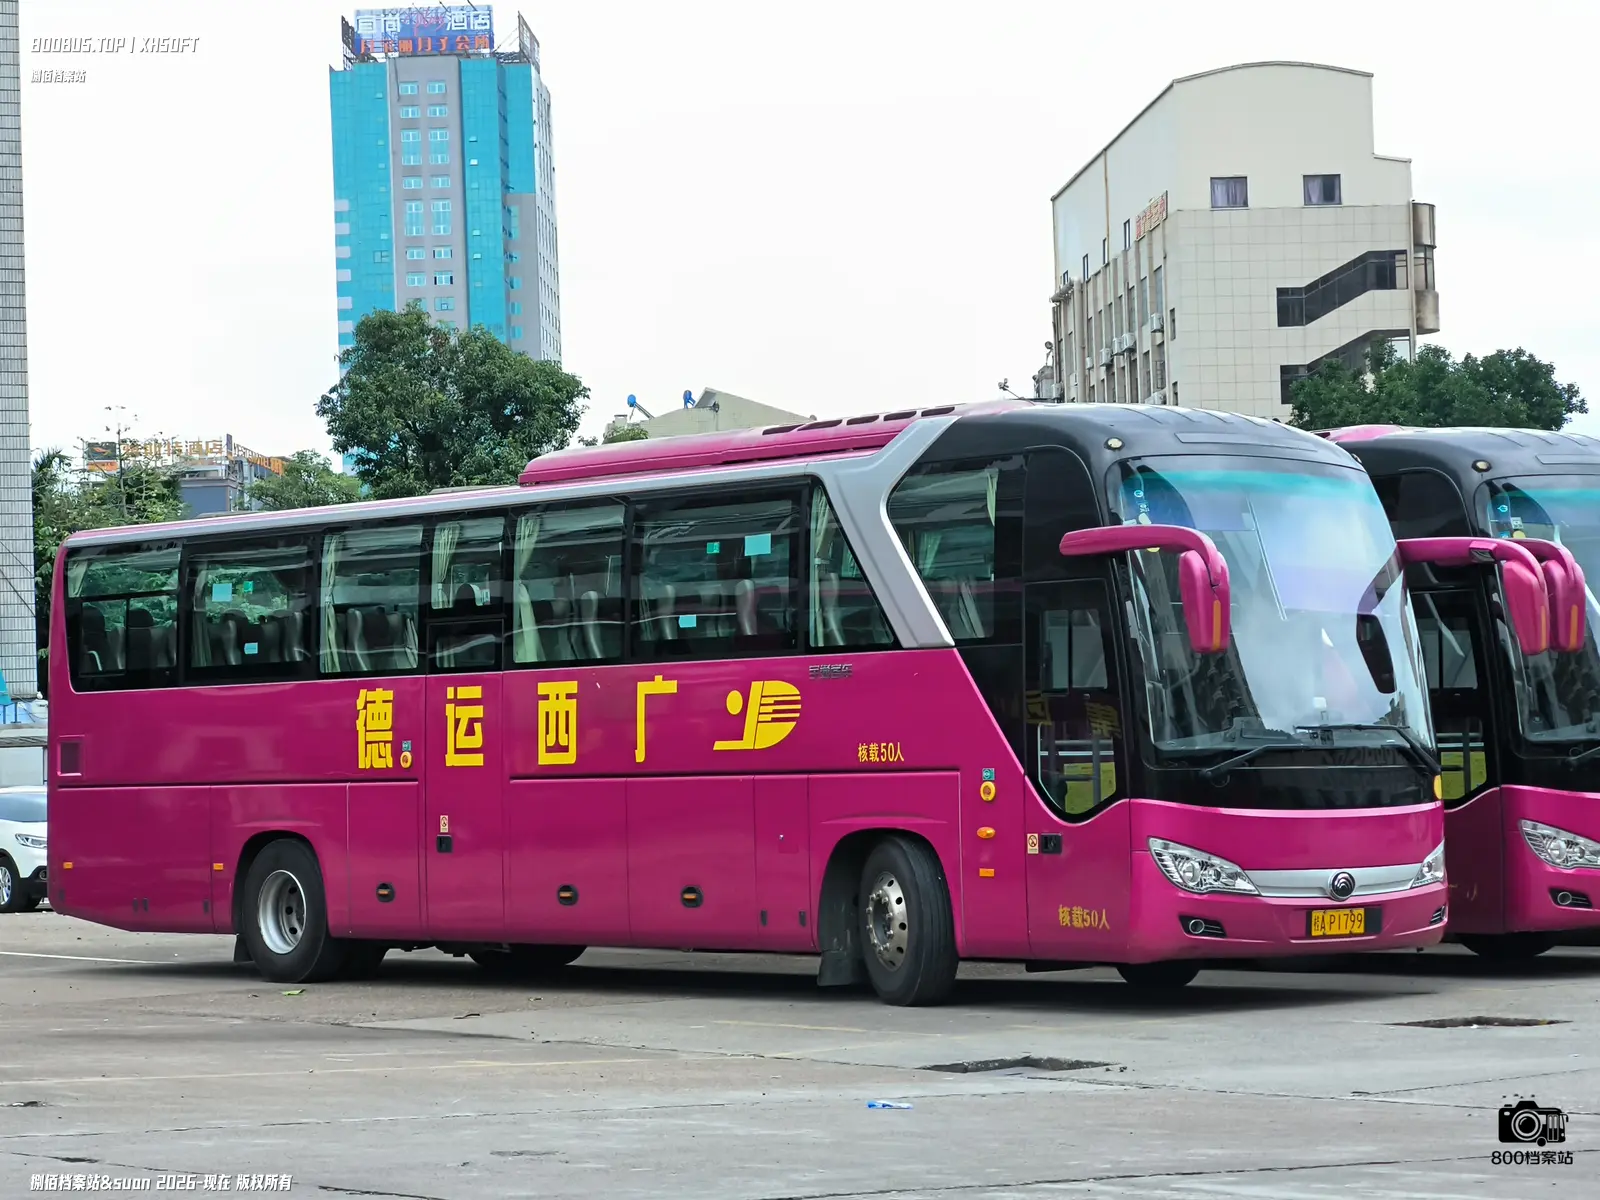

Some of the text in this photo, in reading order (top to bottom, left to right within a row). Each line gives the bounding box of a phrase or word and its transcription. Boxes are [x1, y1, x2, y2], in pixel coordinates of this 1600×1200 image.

[446, 11, 490, 31] 酒店
[857, 742, 905, 763] 核载50人
[1058, 904, 1110, 930] 核载50人
